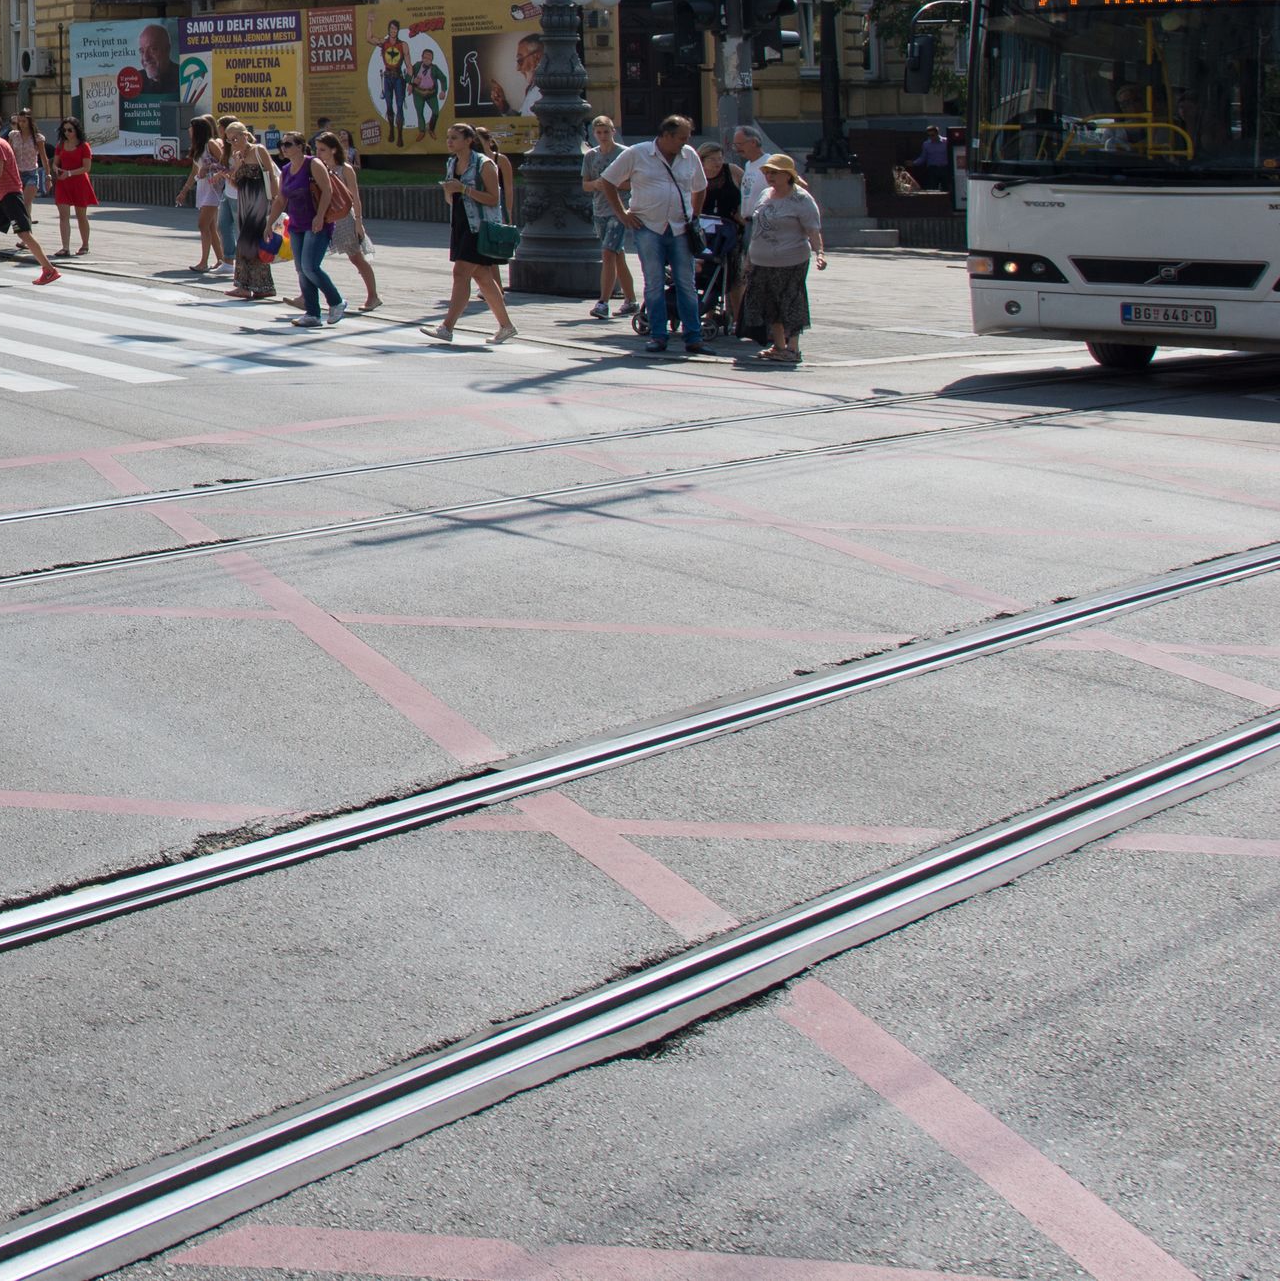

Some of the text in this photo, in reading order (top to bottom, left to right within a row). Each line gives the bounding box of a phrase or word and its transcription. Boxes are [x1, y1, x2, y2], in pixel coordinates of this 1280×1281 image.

[186, 16, 296, 34] SAMO U DELFI SKVERU
[309, 13, 353, 25] INTERNATIONAL
[309, 22, 353, 34] COMICS FESTIVAL
[82, 37, 128, 48] Prvi put na
[187, 31, 296, 46] SVE ZA ŠKOLU NA JEDNOM MESTU
[309, 33, 353, 48] SALON
[75, 47, 136, 60] srpskom jeziku
[310, 48, 353, 64] STRIPA
[225, 57, 281, 70] KOMPLETNA
[234, 72, 272, 84] PONUDA
[85, 86, 118, 100] KOELJO
[124, 82, 130, 92] 2
[221, 85, 288, 99] UDŽBENIKA ZA
[123, 100, 147, 110] Riznica
[217, 99, 292, 113] OSNOVNU ŠKOLU
[1133, 307, 1152, 320] BG
